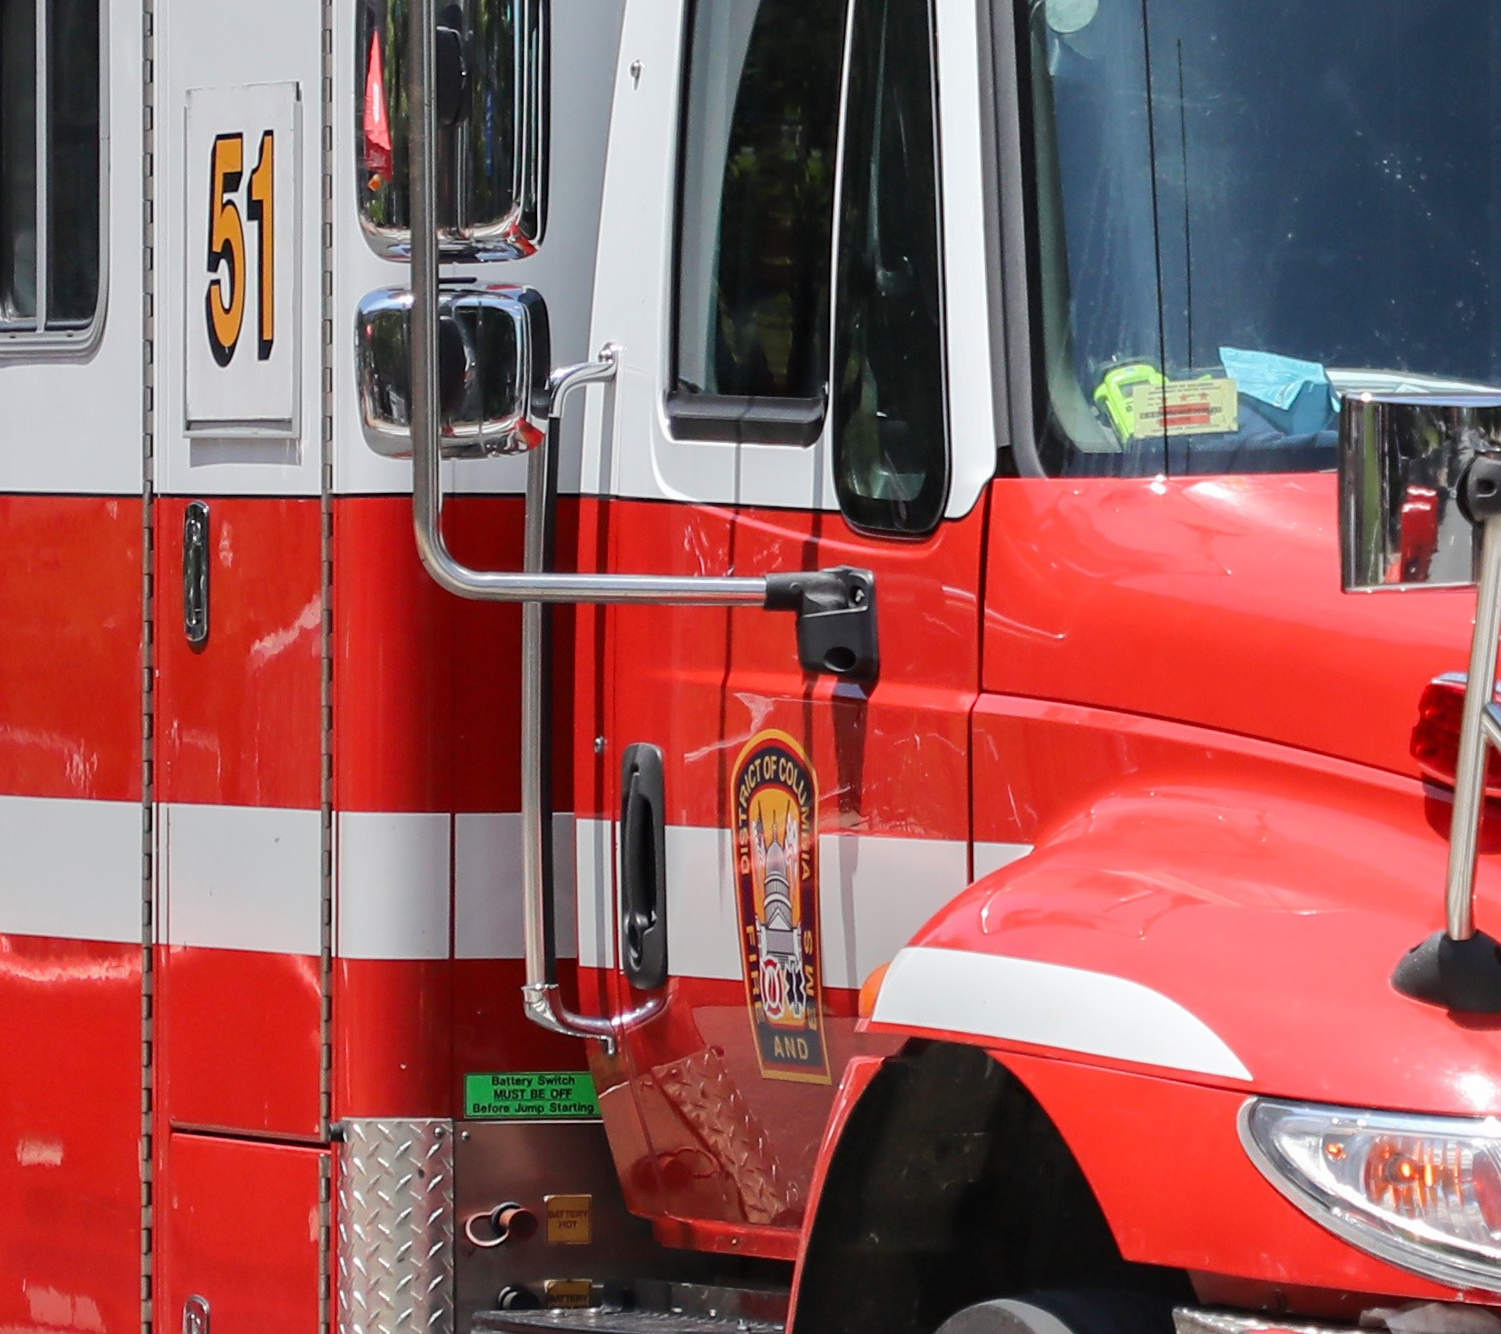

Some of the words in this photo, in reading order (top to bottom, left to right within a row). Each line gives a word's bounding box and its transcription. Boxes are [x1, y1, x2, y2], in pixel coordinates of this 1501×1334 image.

[205, 129, 275, 368] 51
[738, 757, 761, 875] DISTRICT
[762, 755, 778, 779] OF
[778, 757, 812, 880] COLUMBIA
[746, 925, 766, 1024] FIRE
[803, 930, 818, 1031] EMS
[773, 1035, 810, 1061] AND
[473, 1103, 510, 1113] Before
[514, 1103, 545, 1114] Jump
[549, 1102, 595, 1114] Starting
[492, 1075, 532, 1086] Battery
[538, 1075, 575, 1086] Switch
[494, 1089, 526, 1100] MUST
[530, 1089, 546, 1100] BE
[550, 1089, 573, 1100] OFF
